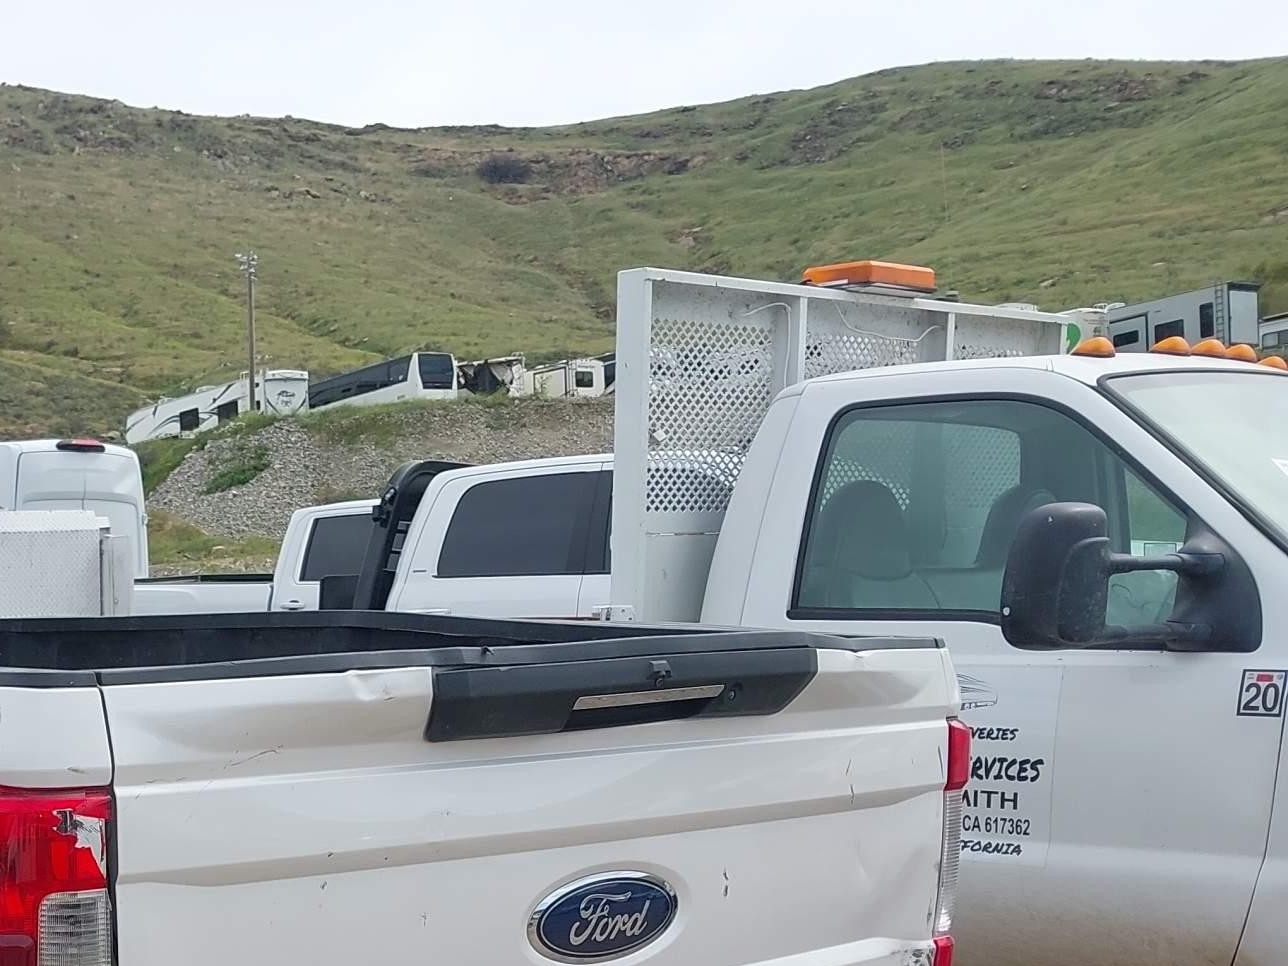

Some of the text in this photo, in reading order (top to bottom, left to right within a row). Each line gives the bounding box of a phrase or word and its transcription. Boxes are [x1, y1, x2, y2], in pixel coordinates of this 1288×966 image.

[1242, 683, 1280, 713] 20
[969, 727, 1019, 741] VERIES
[970, 756, 1044, 782] RVICES
[963, 815, 1030, 836] CA 617362
[960, 840, 1023, 856] FORNIA
[569, 891, 651, 946] Ford
